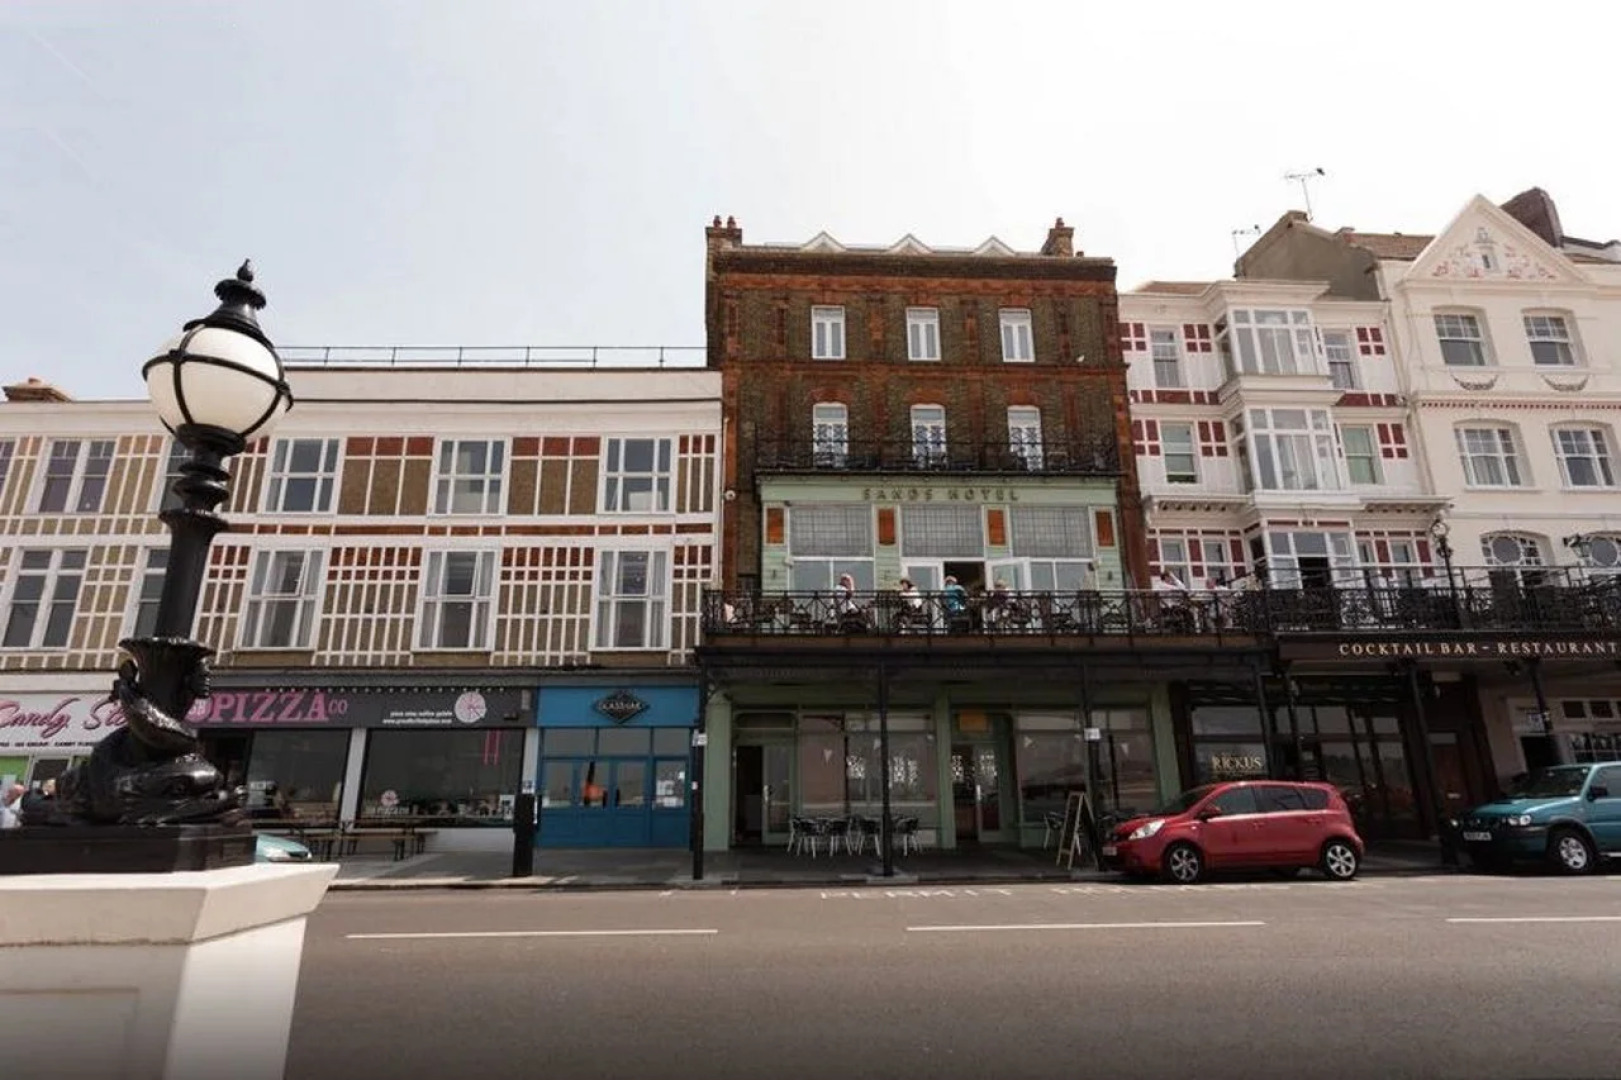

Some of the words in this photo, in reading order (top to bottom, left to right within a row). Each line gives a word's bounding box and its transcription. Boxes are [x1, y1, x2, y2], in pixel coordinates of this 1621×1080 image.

[863, 488, 933, 501] SANDS
[948, 488, 1020, 501] HOTEL
[1339, 643, 1434, 655] COCKTAIL
[1440, 643, 1477, 654] BAR
[1497, 642, 1618, 654] RESTAURANT
[208, 691, 329, 722] PIZZA
[328, 699, 348, 715] CO
